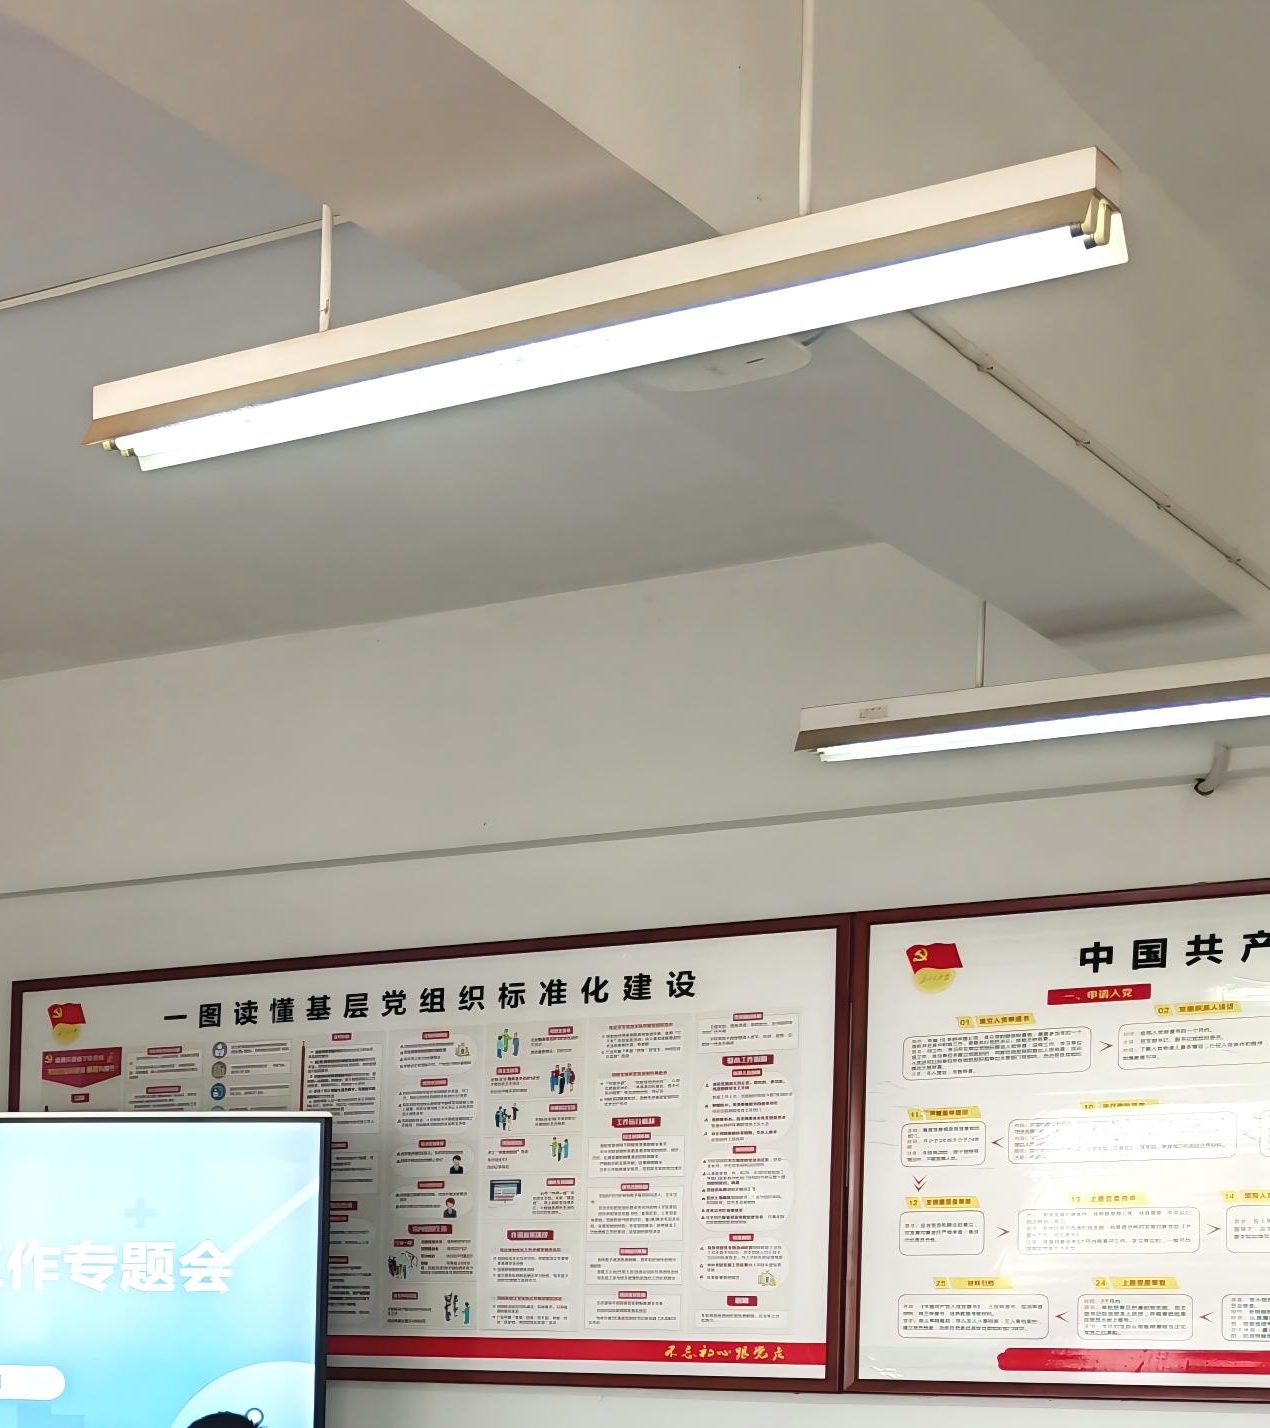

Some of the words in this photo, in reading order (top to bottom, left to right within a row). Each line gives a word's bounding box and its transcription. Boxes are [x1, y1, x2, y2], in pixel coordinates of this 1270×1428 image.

[1079, 930, 1270, 973] 中国共产
[163, 970, 697, 1028] 一图读懂基层党组织标准化建设
